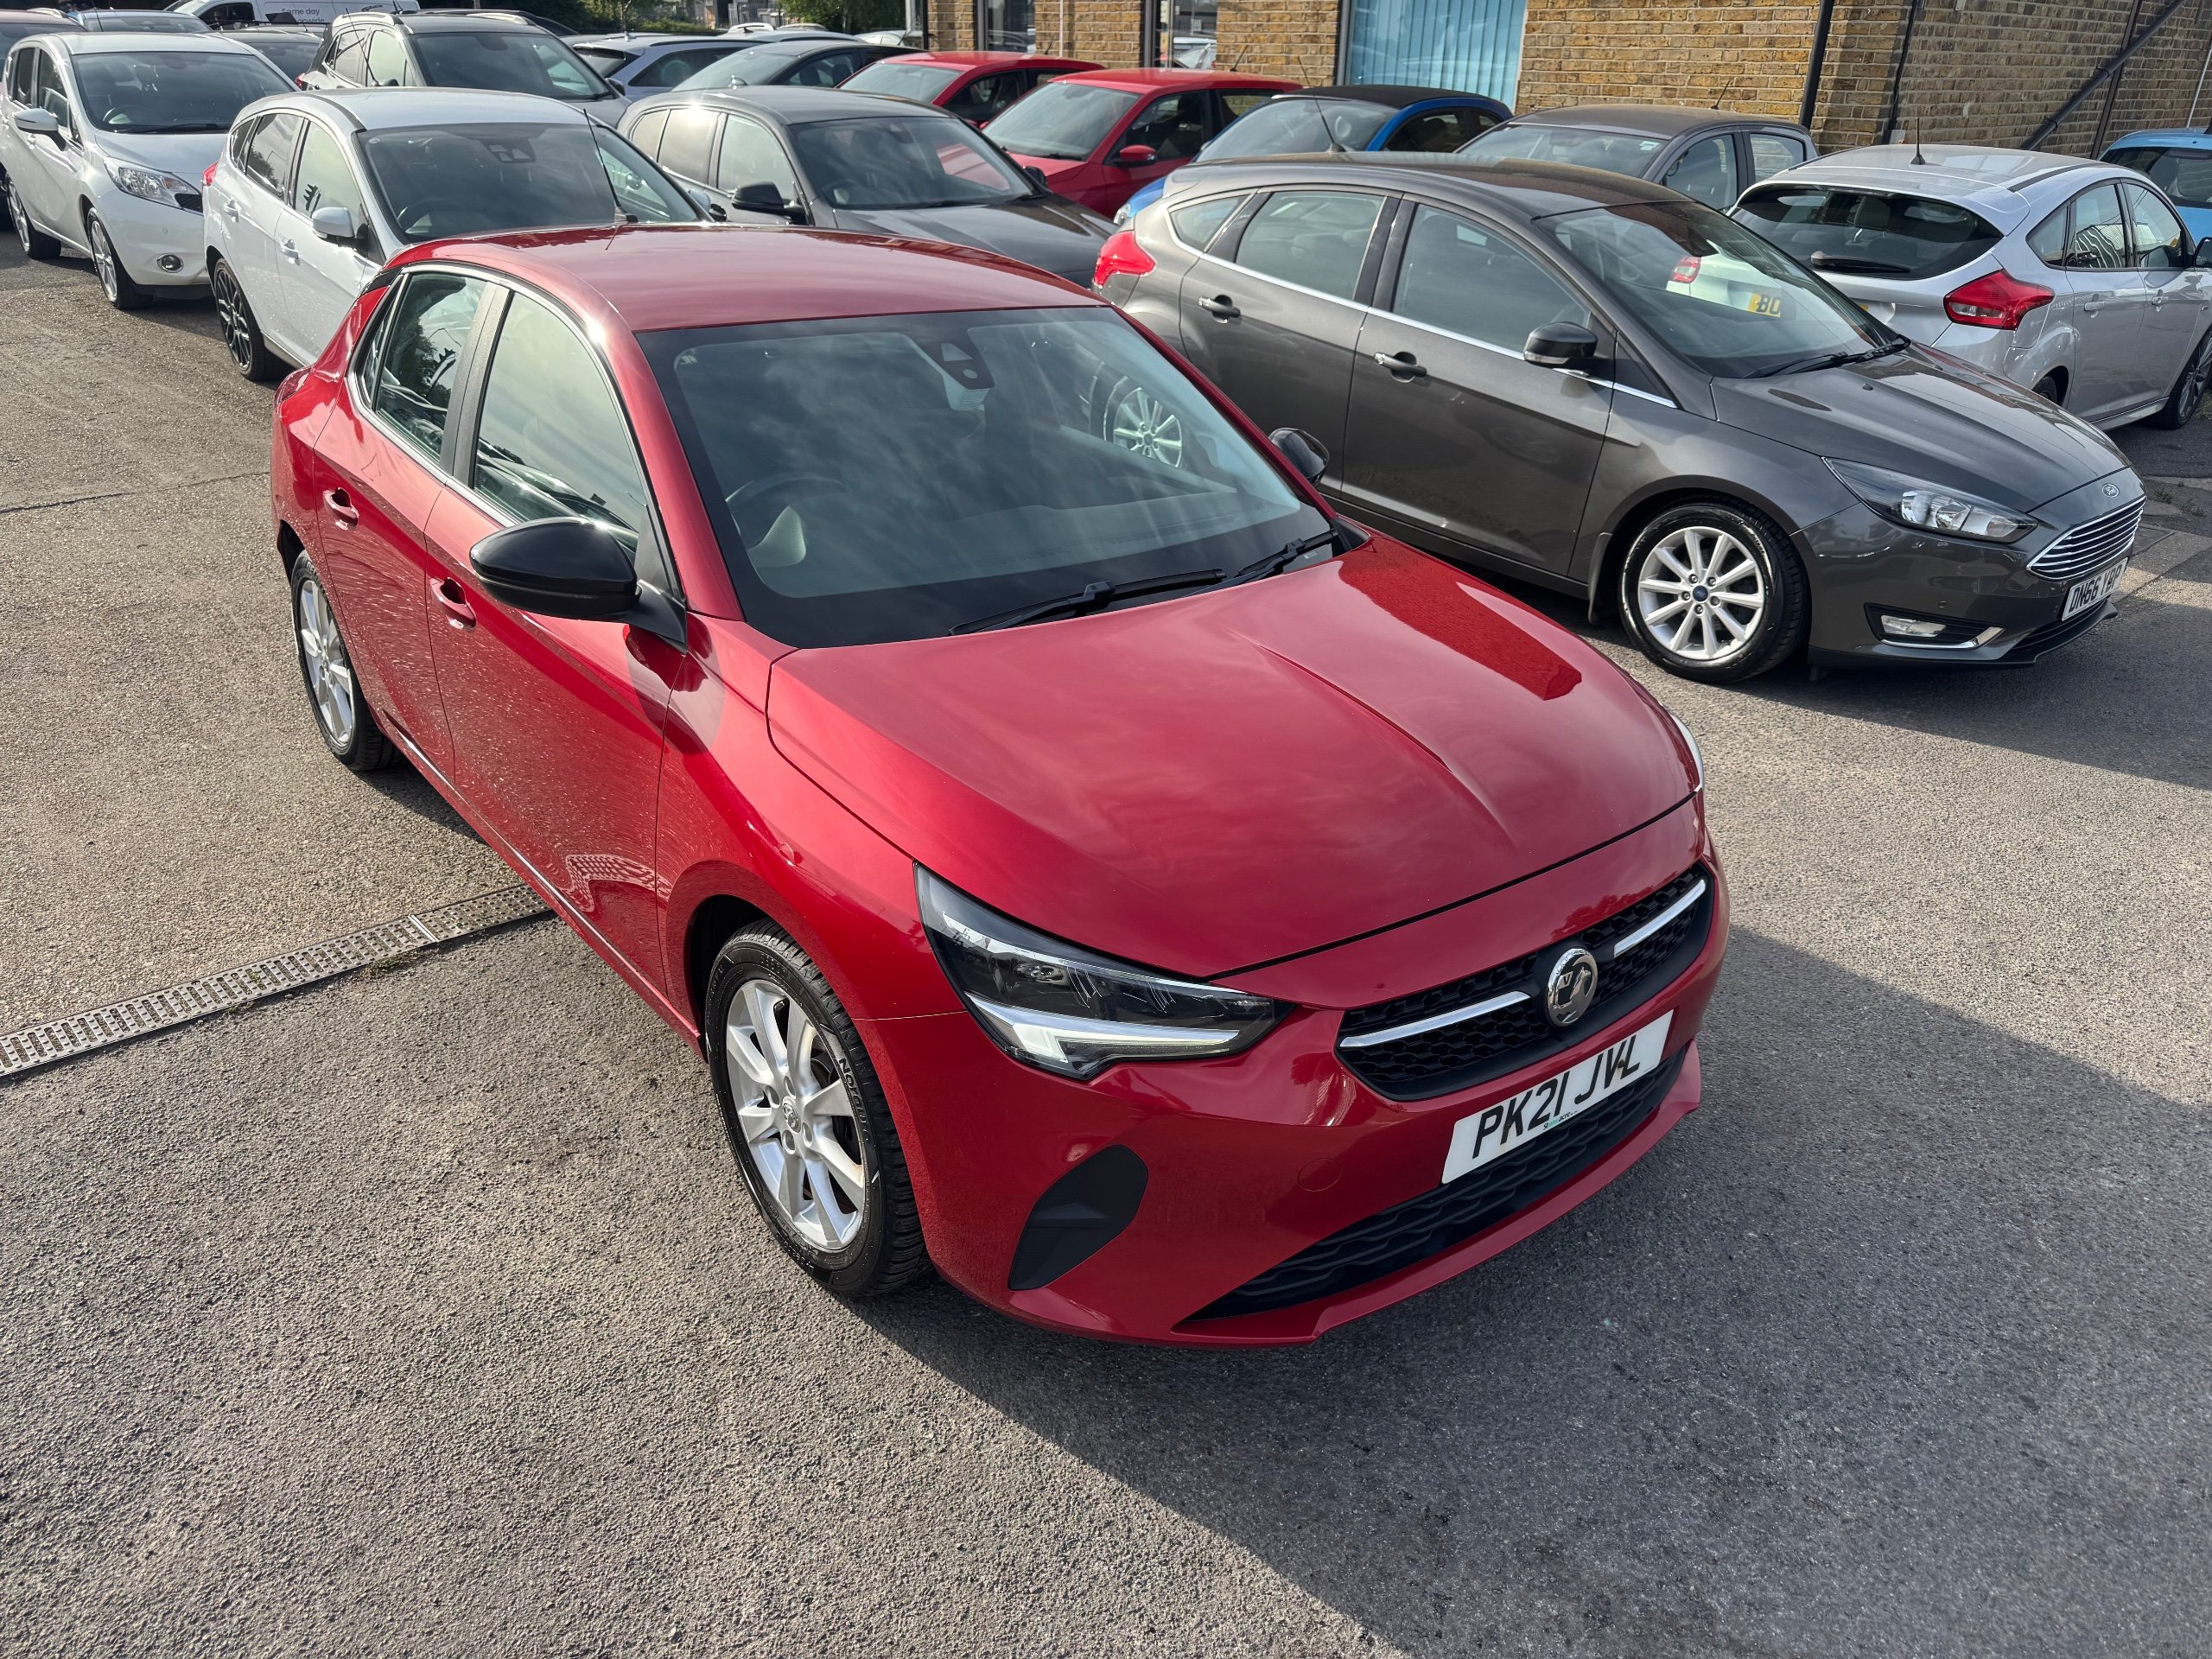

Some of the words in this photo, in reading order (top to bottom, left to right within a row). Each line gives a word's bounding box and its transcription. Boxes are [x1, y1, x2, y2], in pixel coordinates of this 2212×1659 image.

[305, 8, 321, 16] day
[2068, 575, 2102, 613] DN66
[2101, 563, 2123, 596] YBP
[1471, 1071, 1570, 1160] PK21
[1573, 1034, 1641, 1105] JVL
